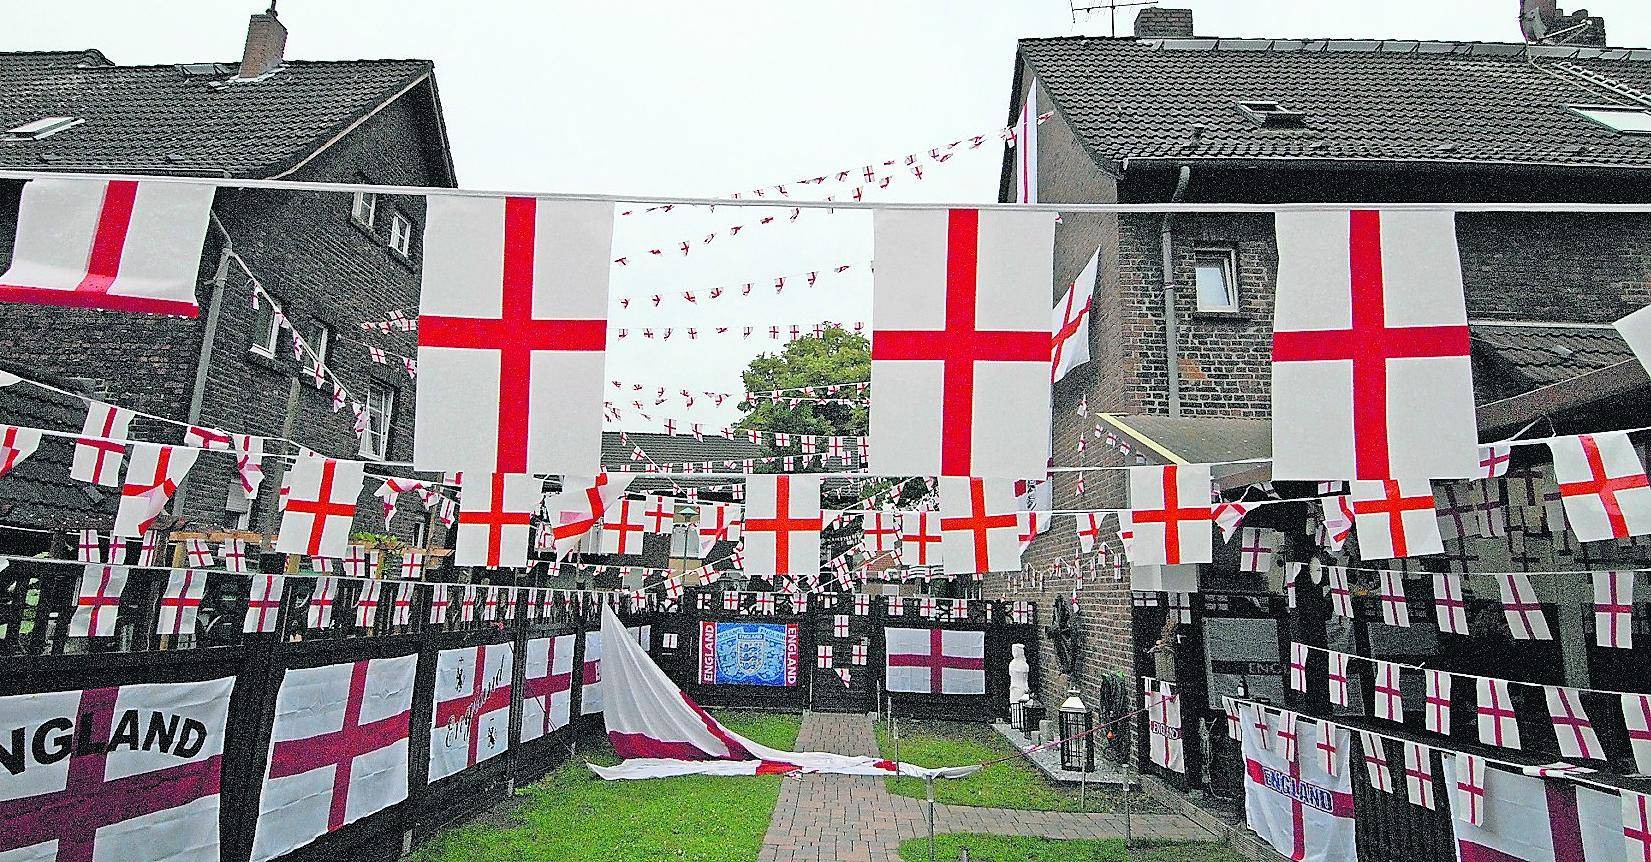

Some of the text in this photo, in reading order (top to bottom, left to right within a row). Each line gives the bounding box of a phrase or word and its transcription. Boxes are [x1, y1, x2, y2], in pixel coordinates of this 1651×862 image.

[704, 625, 714, 681] ENGLAND
[787, 628, 797, 684] ENGLAND
[0, 709, 208, 775] NGLAND
[1263, 768, 1333, 812] ENGLAND
